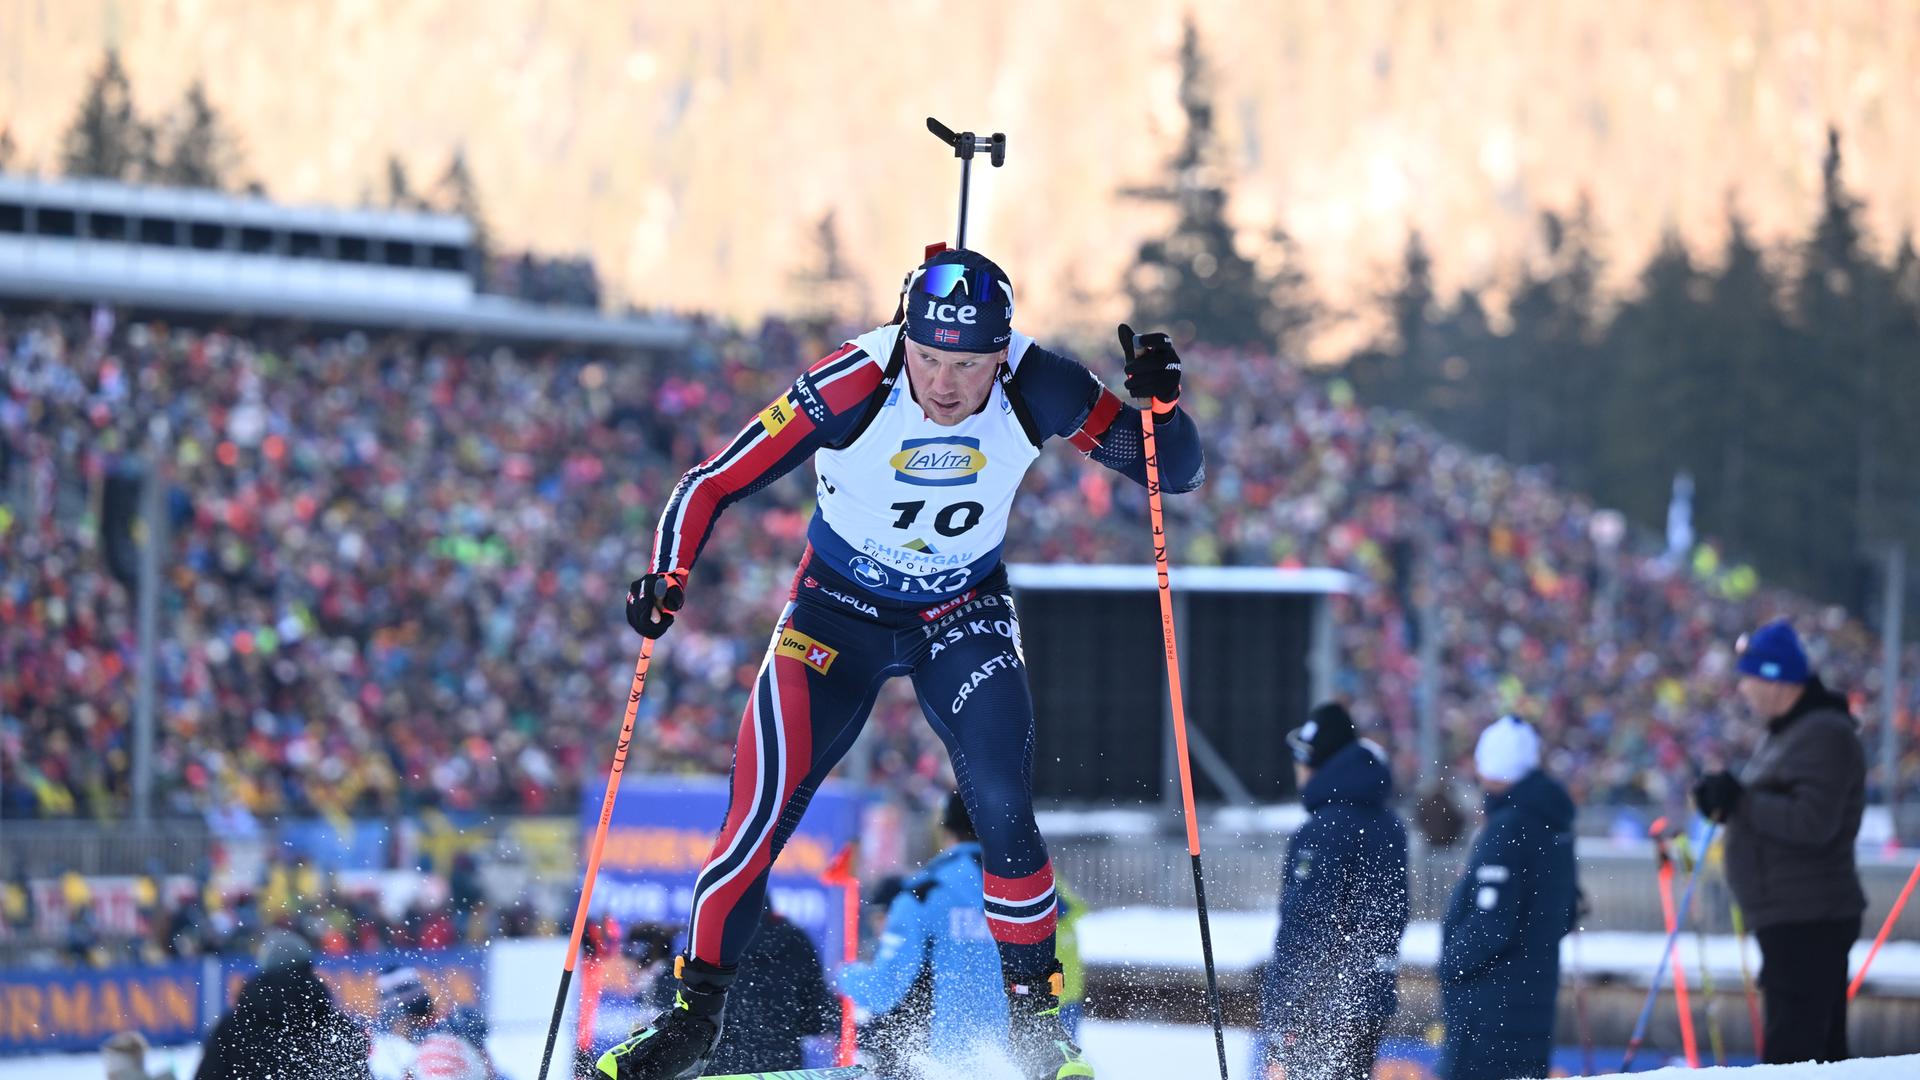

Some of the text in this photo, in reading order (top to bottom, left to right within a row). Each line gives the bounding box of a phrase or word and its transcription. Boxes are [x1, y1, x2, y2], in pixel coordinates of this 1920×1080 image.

[796, 373, 818, 404] RAFT
[890, 499, 985, 538] 10
[819, 586, 879, 618] LAPUA
[926, 591, 972, 620] MENY
[782, 636, 807, 652] Uno
[951, 655, 1008, 714] CRAFT
